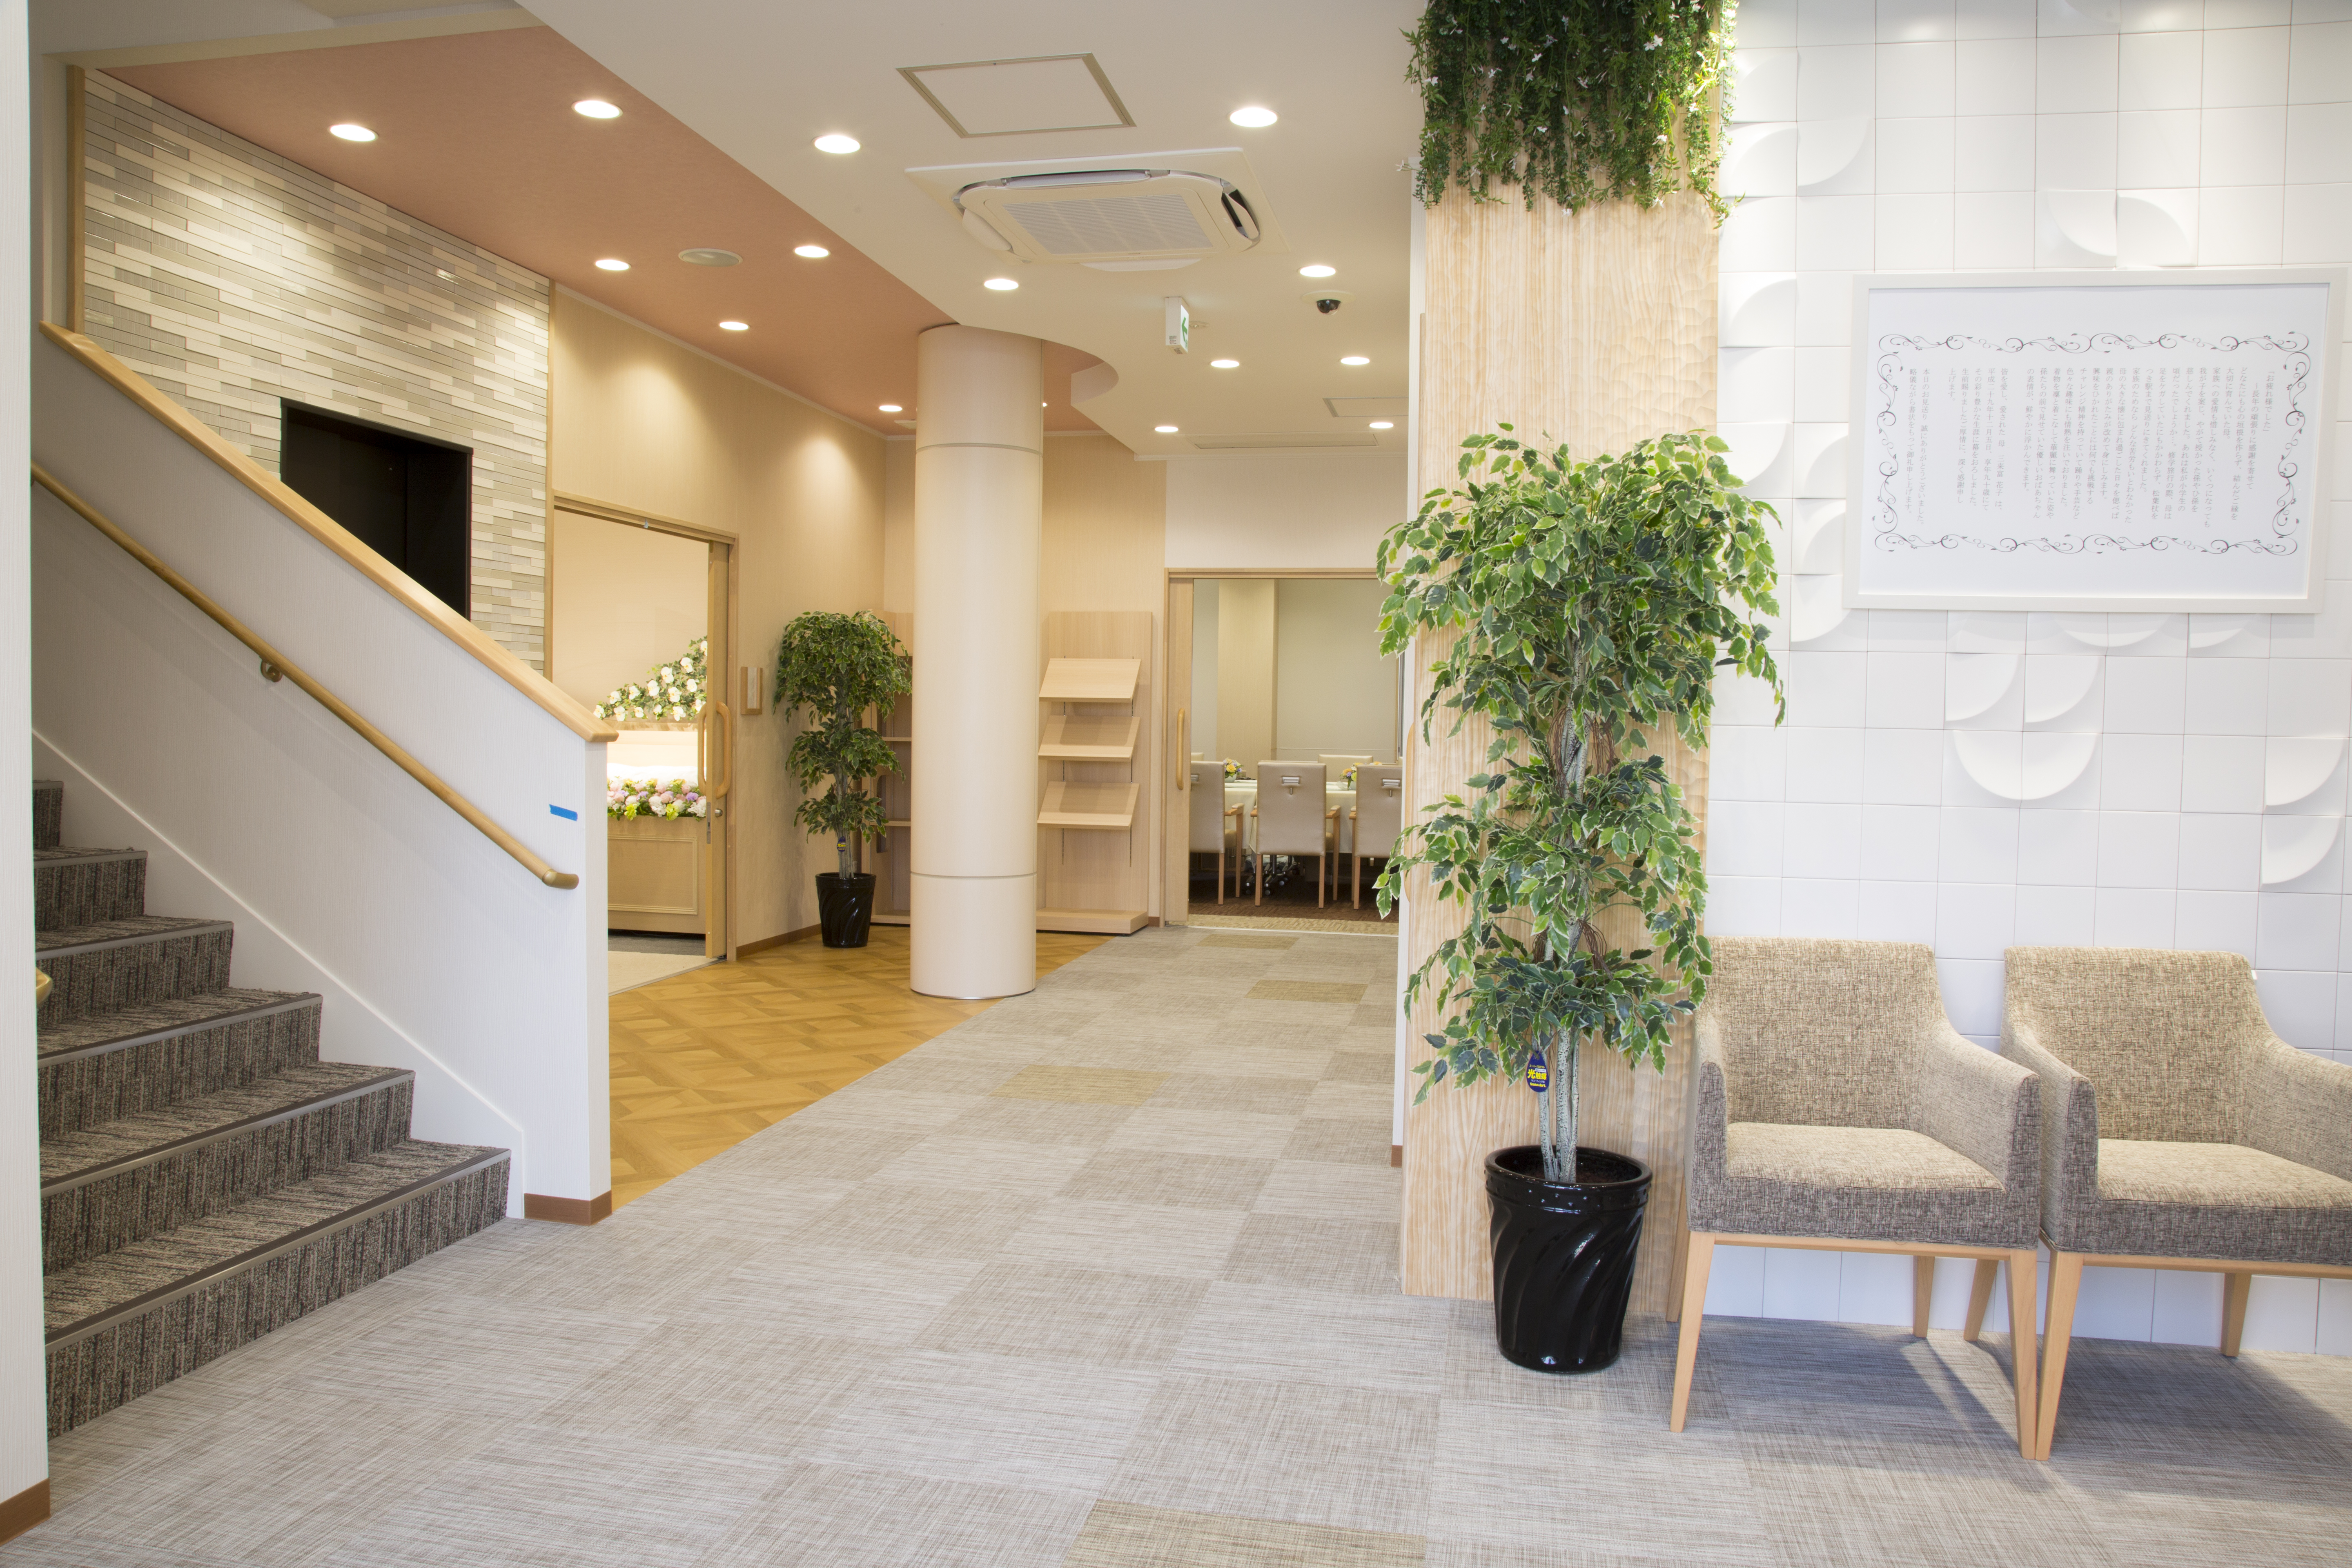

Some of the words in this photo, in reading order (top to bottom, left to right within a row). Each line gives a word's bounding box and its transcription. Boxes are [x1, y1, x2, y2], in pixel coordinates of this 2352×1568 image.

[1904, 368, 1918, 514] 略儀ながら書状をもって御礼申し上げます。
[1948, 368, 1956, 401] 上げます。
[1956, 368, 1969, 504] 生前賜りましたご厚情に、深く感謝申し
[1969, 368, 1982, 507] その彩り豊かな生涯に幕をおろしました。
[1982, 368, 1996, 511] 平成二十九年十二月五日、享年九十歳にて
[2022, 368, 2035, 492] の表情が、鮮やかに浮かんできます。
[2033, 367, 2048, 519] 孫たちの前で見せていた優しいおばあちゃん
[2060, 367, 2074, 507] 色々な趣味にも情熱を注いでおりました。
[2073, 368, 2087, 520] チャレンジ精神を持っていて踊りや手芸など
[2087, 368, 2100, 505] 興味をひかれたことには何でも挑戦する
[2100, 368, 2114, 500] 親のありがたみが改めて身にしみます。
[2111, 368, 2127, 520] 母の大きな懐に包まれ過ごした日々を偲べば
[2140, 369, 2154, 492] つき駅まで見送りにきてくれました。
[2151, 368, 2167, 520] 足をケガしていたにもかかわらず、松葉杖を
[2178, 367, 2194, 512] 慈しんでくれました。あれは私が小学生の
[2191, 367, 2207, 513] 我が子を案じ、やがて授かった孫やひ孫を
[2204, 367, 2221, 528] 家族への愛情も惜しみなく、いくつになっても
[2223, 367, 2234, 439] 大切に育んでいた母。
[2230, 367, 2248, 521] どなたにも心の垣根を作らず、結んだご縁を
[2263, 371, 2275, 432] 「お疲れ様でした」
[1528, 1069, 1547, 1080] 光触媒
